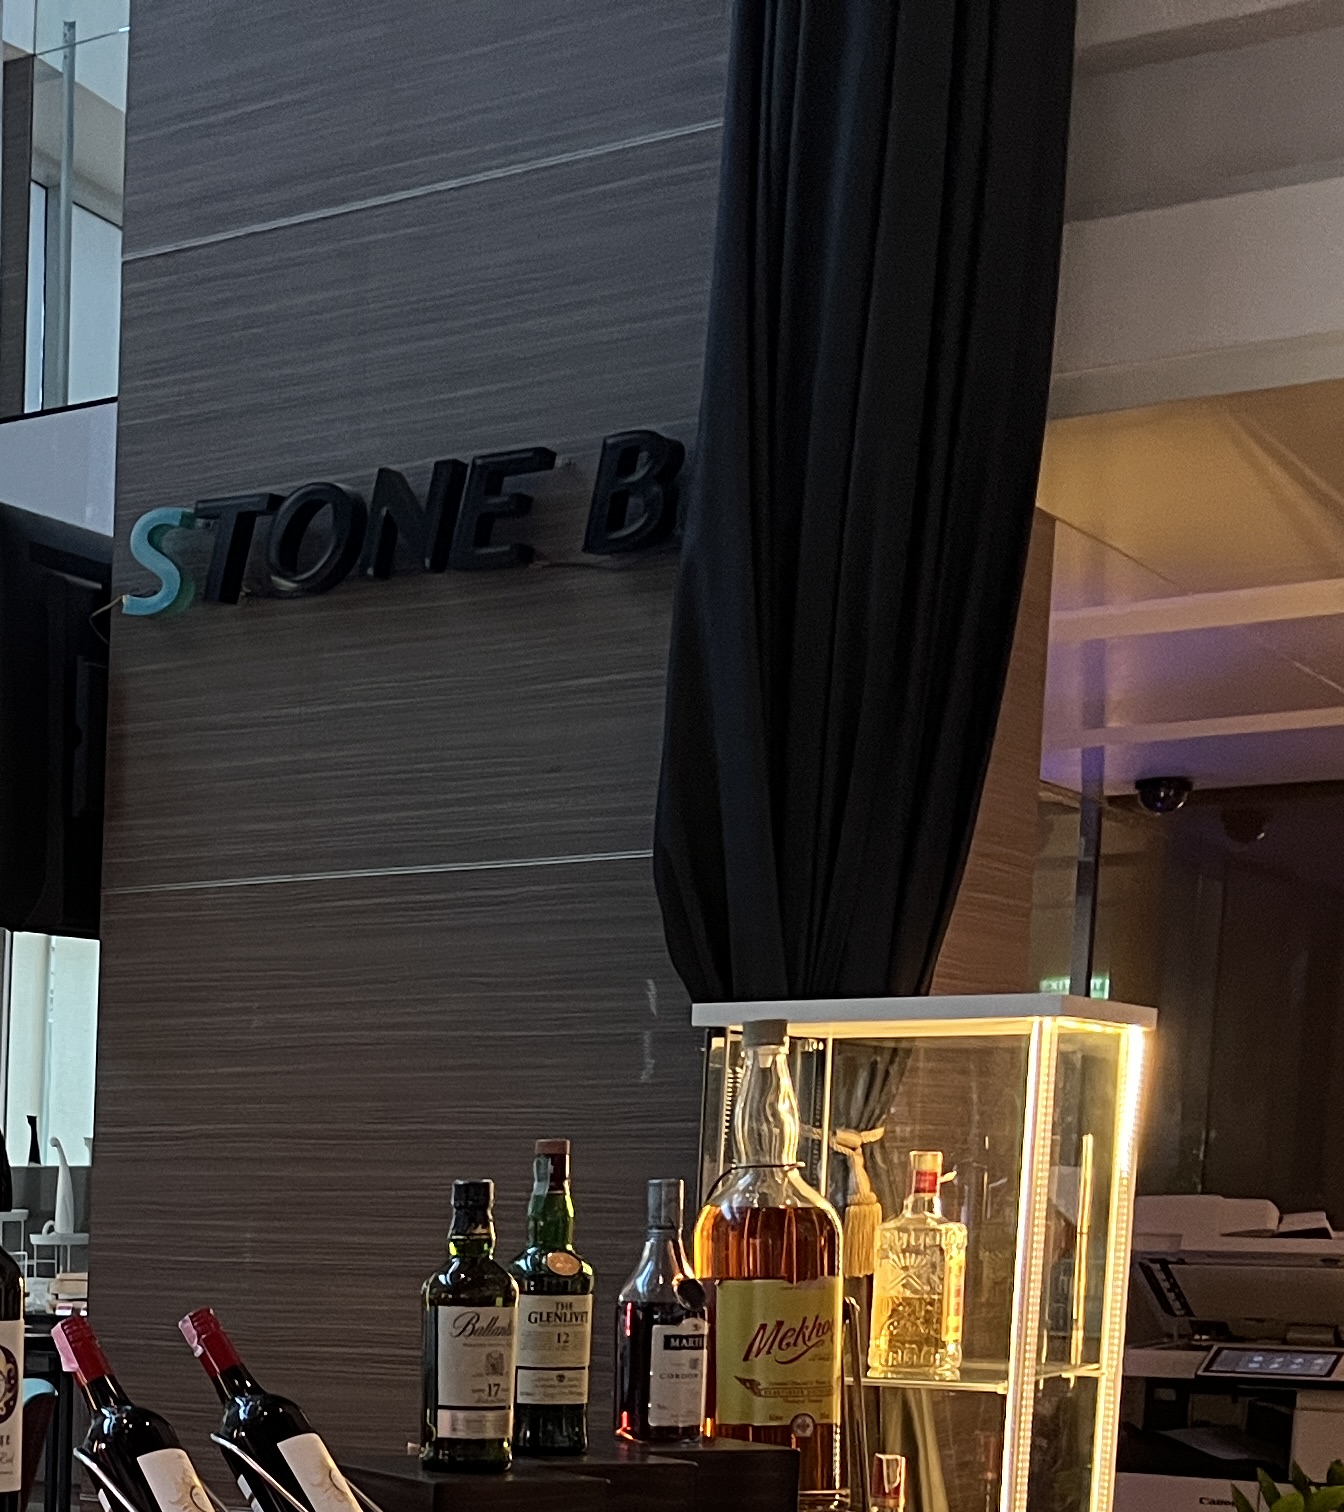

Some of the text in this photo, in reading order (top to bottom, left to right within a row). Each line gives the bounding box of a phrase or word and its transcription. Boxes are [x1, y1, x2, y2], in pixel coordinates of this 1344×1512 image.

[123, 446, 556, 616] STONE
[555, 1301, 574, 1311] THE
[556, 1332, 570, 1344] 12
[742, 1313, 835, 1365] Mekho
[488, 1383, 501, 1398] 17
